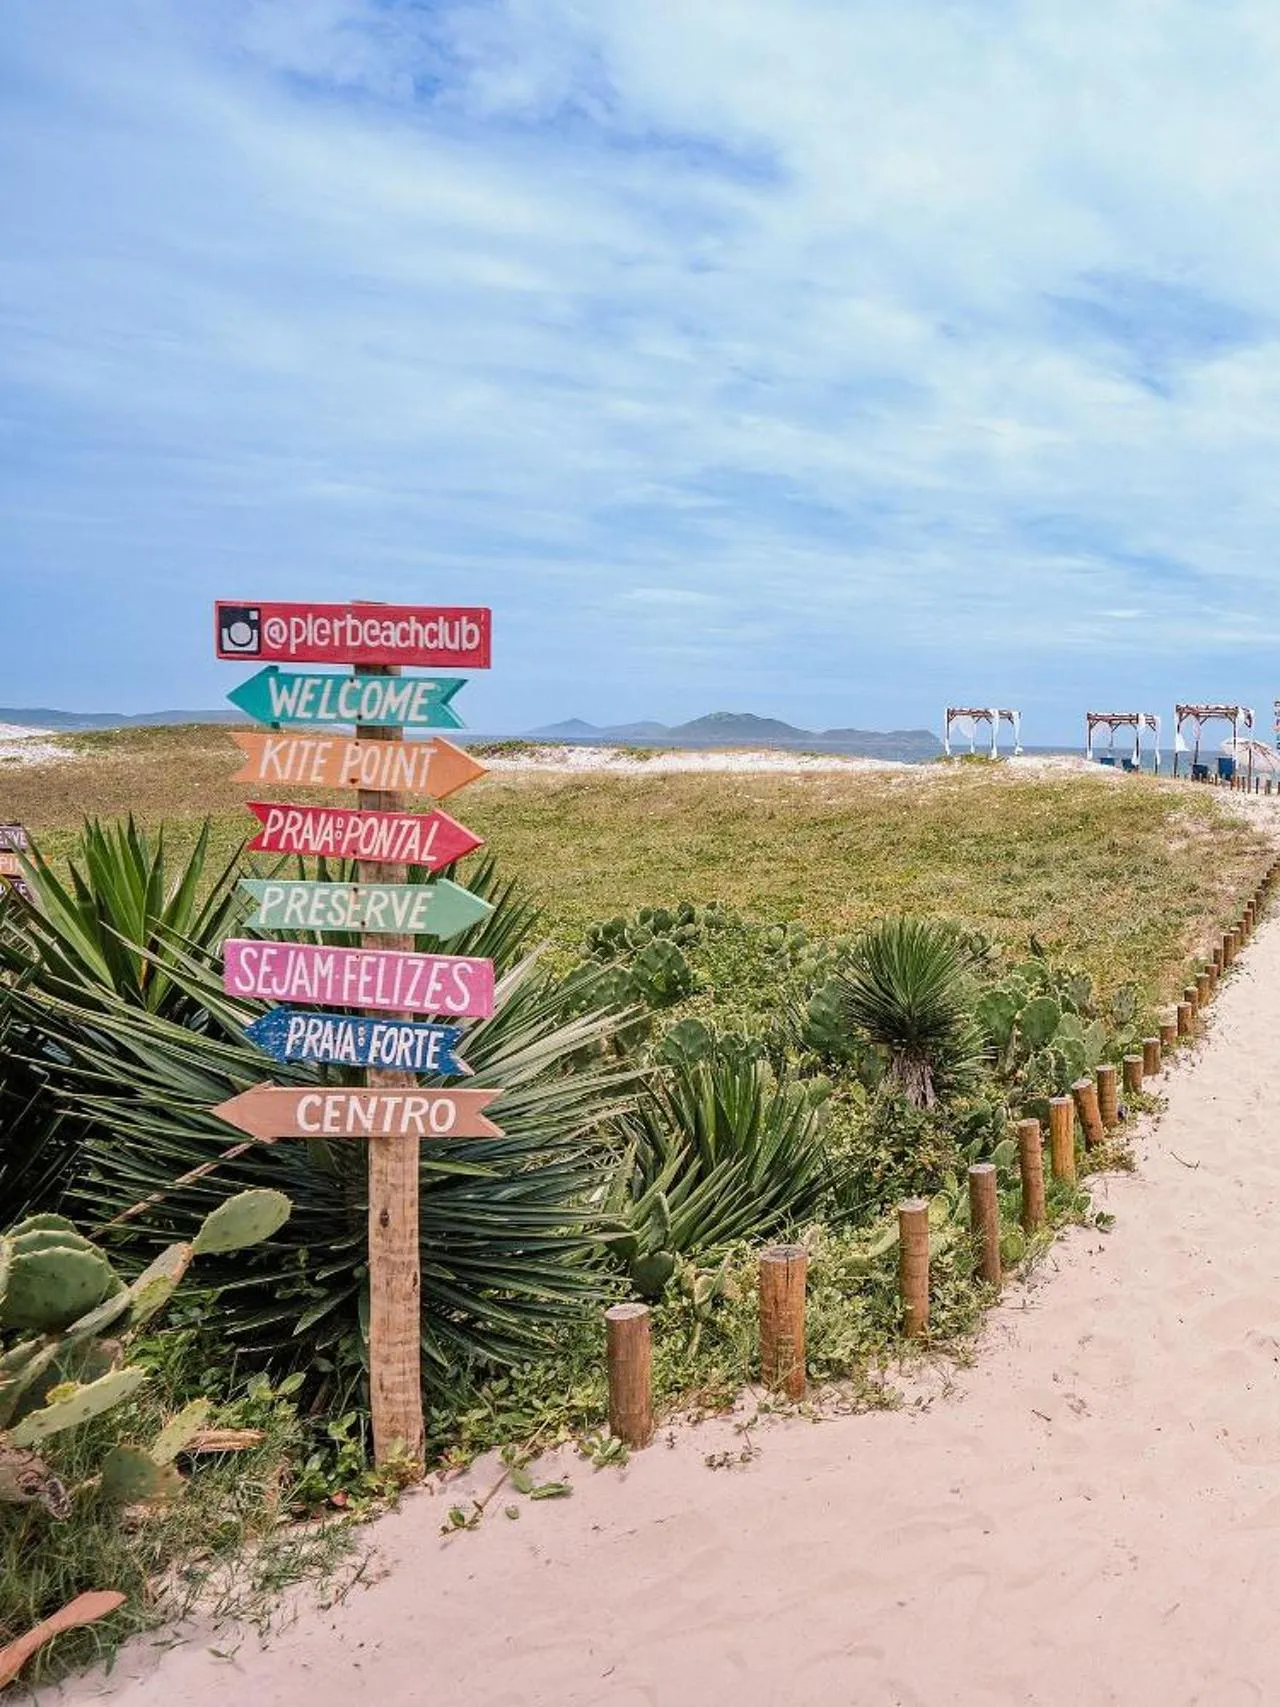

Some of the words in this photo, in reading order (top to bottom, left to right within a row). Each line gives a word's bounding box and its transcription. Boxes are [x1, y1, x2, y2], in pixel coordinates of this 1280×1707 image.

[268, 676, 436, 722] WELCOME
[259, 738, 333, 782] KITE
[339, 745, 438, 789] POINT
[261, 808, 334, 851] PRAIA
[340, 815, 440, 862] PONTAL
[258, 886, 433, 930] PRESERVE
[234, 947, 334, 1000] SEJAM
[339, 955, 473, 1012] FELIZES
[285, 1016, 357, 1062] PRAIA
[368, 1024, 445, 1070] FORTE
[296, 1094, 457, 1134] CENTRO
